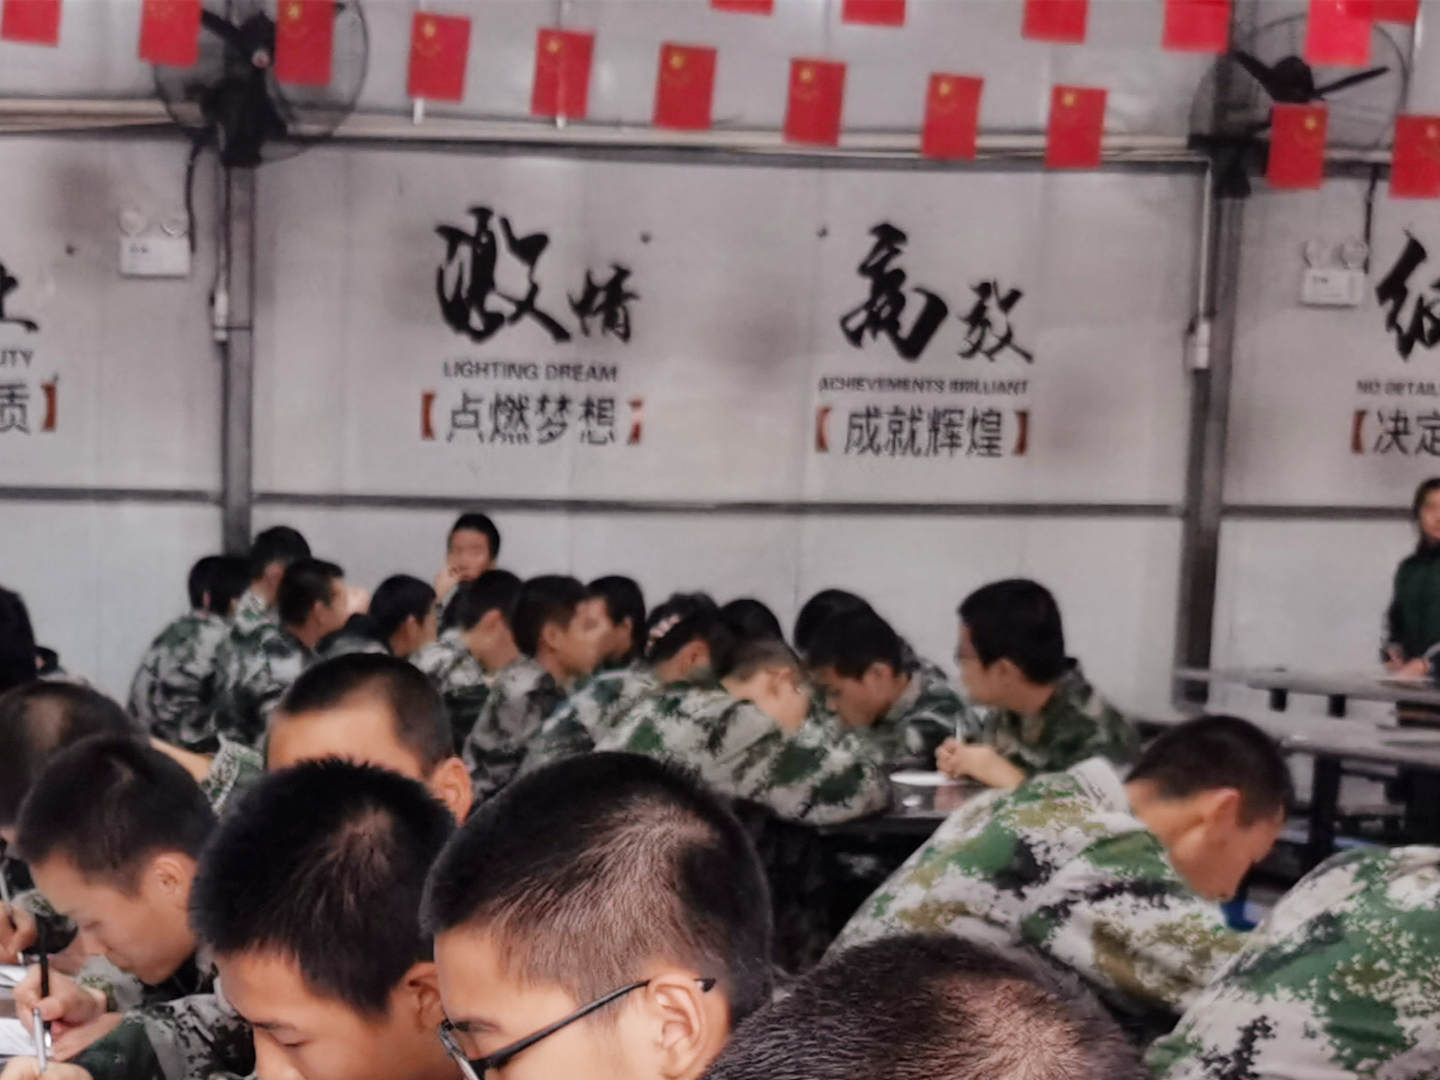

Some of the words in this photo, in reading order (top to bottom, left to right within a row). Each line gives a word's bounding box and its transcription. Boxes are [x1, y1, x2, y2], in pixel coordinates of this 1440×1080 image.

[840, 223, 1034, 363] 高效
[443, 361, 538, 381] LIGHTING
[545, 363, 618, 383] DREAM
[818, 375, 945, 393] ACHIEVEMENTS
